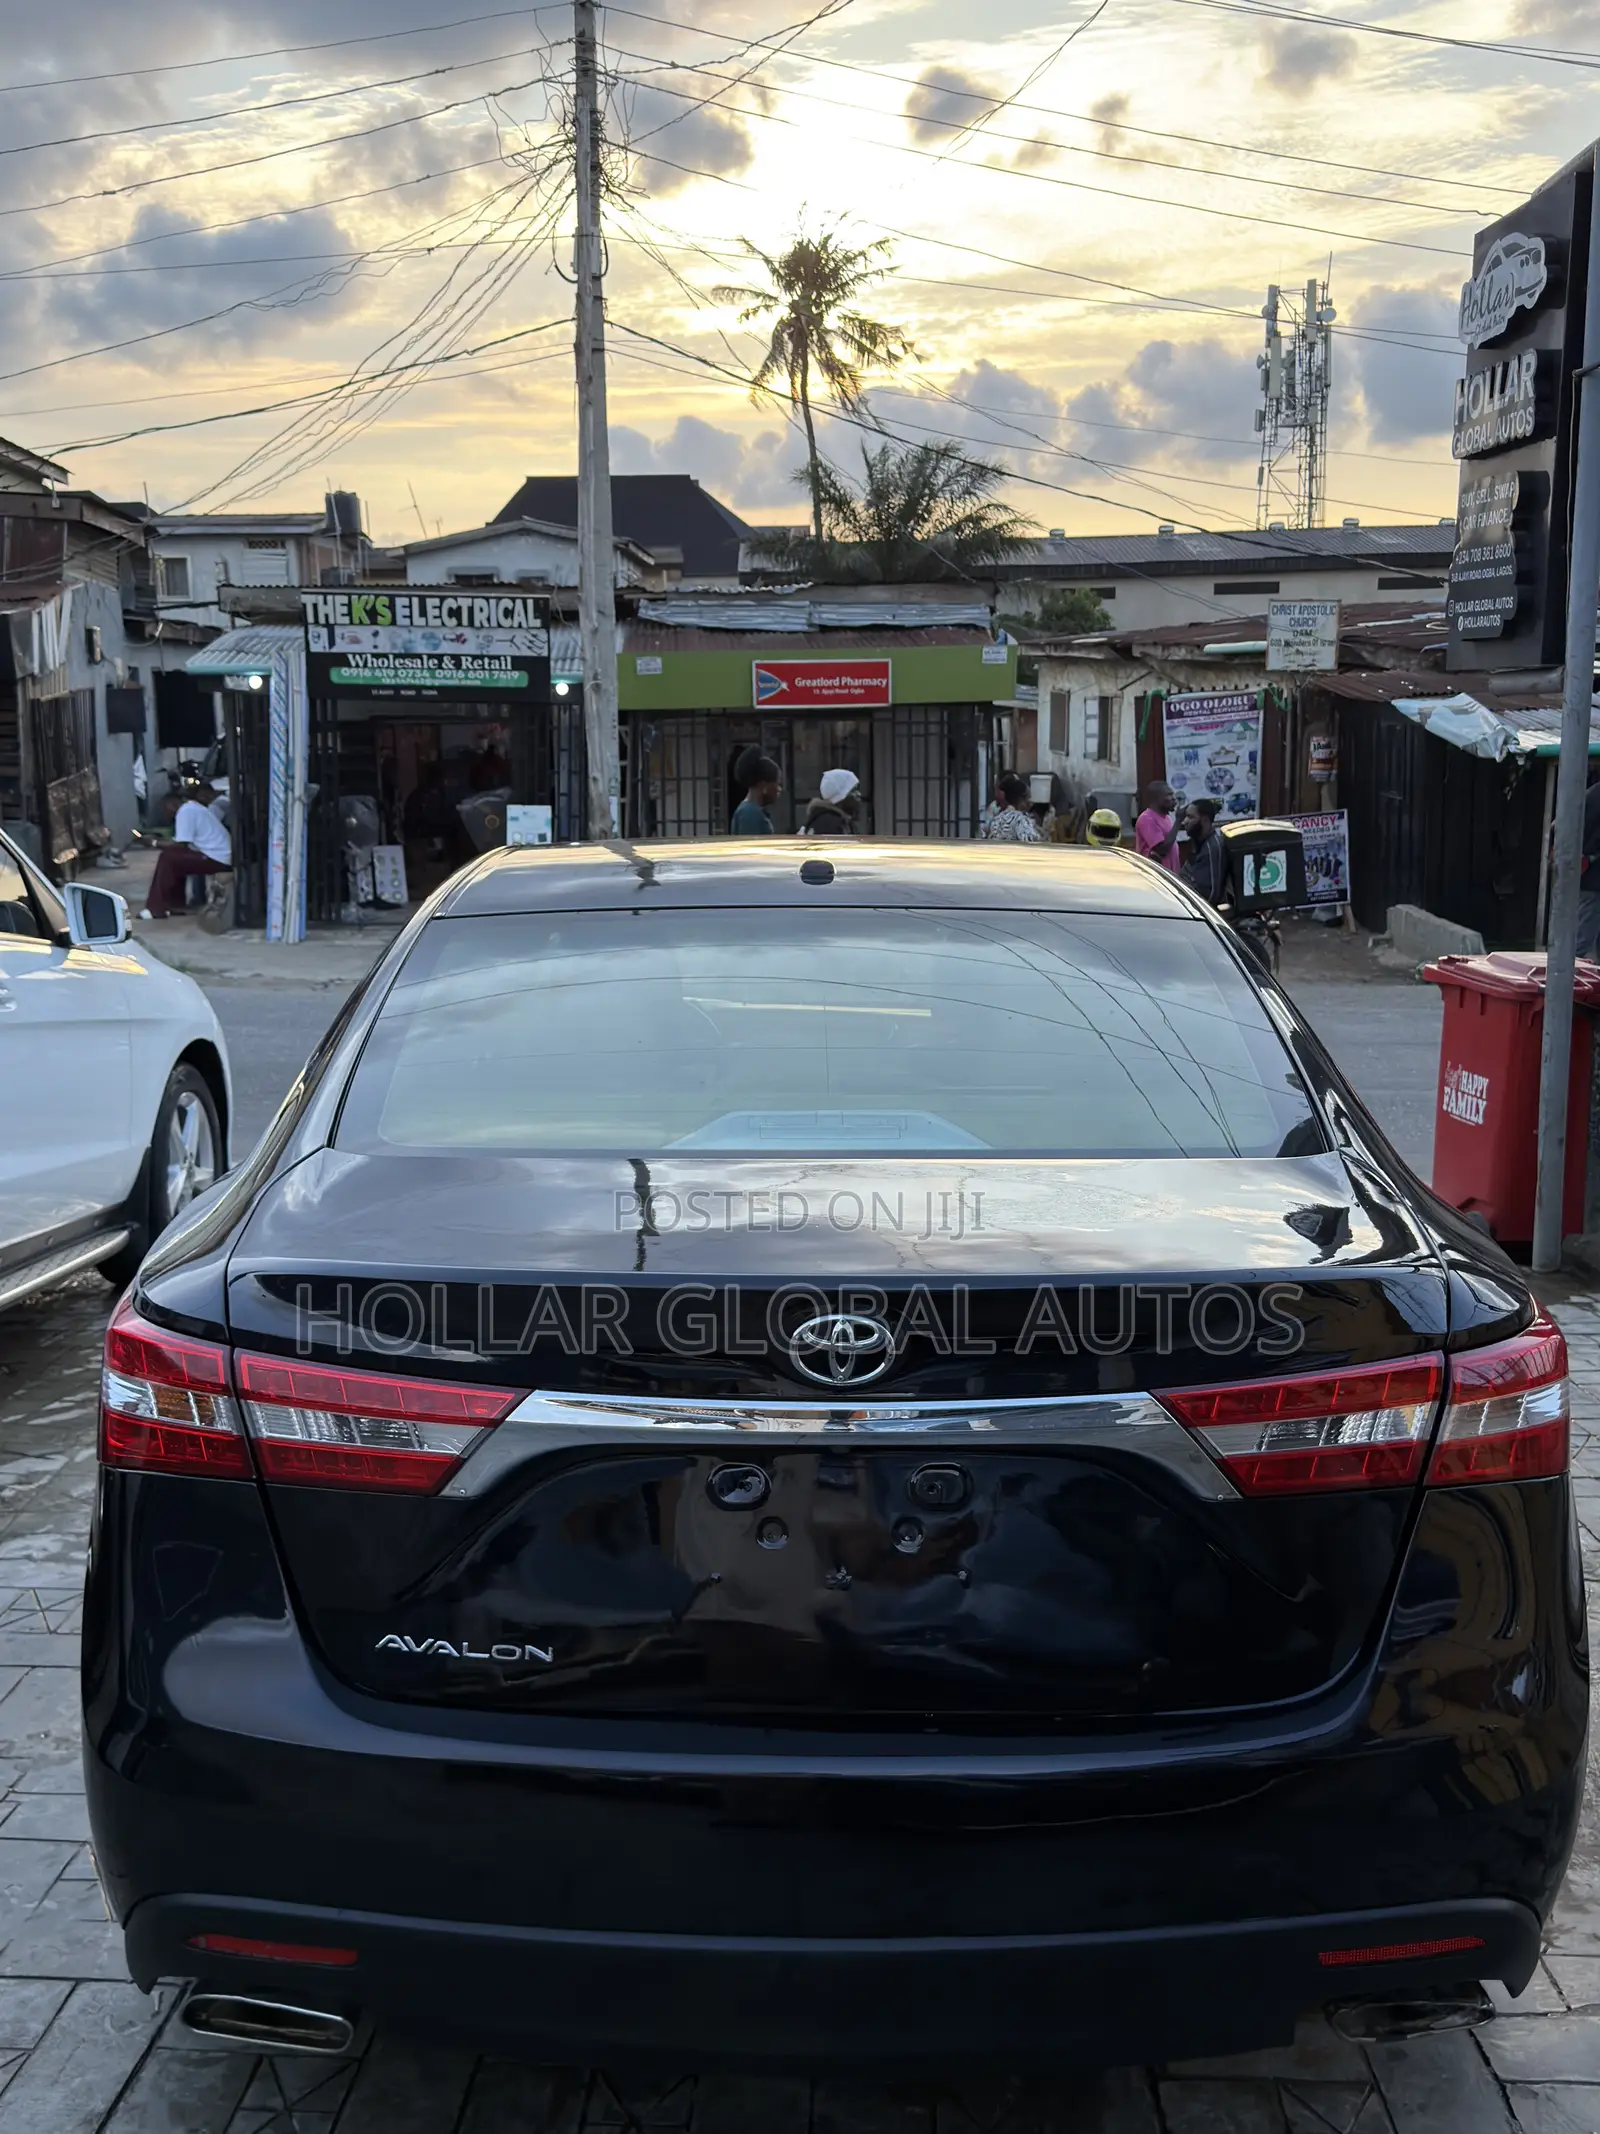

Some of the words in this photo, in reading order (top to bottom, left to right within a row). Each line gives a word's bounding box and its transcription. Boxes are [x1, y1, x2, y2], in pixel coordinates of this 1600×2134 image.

[1461, 274, 1514, 330] Hollar
[1455, 352, 1535, 426] HOLLAR
[1453, 424, 1494, 456] GLOBAL
[1495, 407, 1535, 443] AUTOS
[395, 597, 542, 628] ELECTRICAL
[1271, 604, 1297, 616] CHRIST
[1298, 604, 1337, 616] APOSTOLIC
[1455, 600, 1474, 613] HOLLAR
[1474, 598, 1494, 612] GLOBAL
[1495, 596, 1513, 610] AUTOS
[1288, 617, 1317, 628] CHURCH
[1464, 614, 1501, 628] HOLLARAUTOS
[346, 653, 438, 669] Wholesale
[441, 656, 456, 669] &
[460, 655, 513, 670] Retail
[795, 676, 840, 688] Greatlord
[841, 676, 887, 689] Pharmacy
[1170, 700, 1200, 713] OGO
[1461, 1069, 1489, 1099] HAPPY
[1443, 1086, 1487, 1125] FAMILY
[375, 1633, 554, 1663] AVALON
